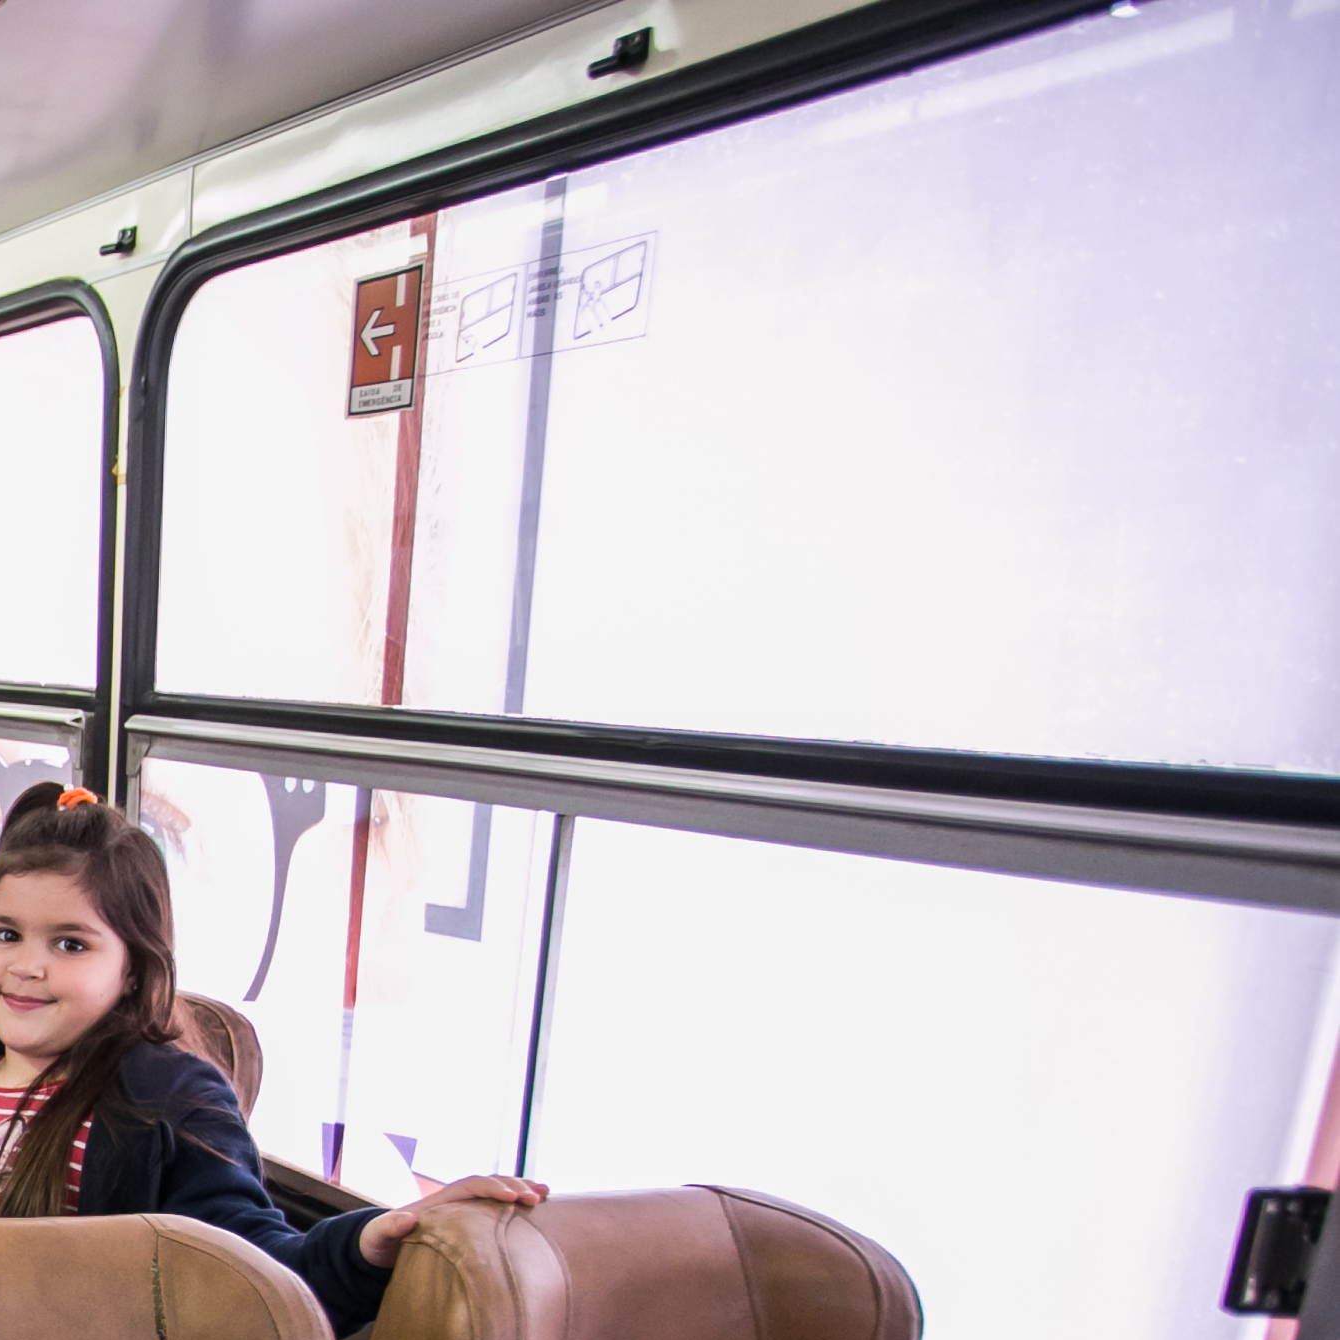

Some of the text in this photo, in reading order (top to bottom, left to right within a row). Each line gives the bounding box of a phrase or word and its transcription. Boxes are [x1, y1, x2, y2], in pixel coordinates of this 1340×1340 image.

[359, 383, 403, 398] SAÍDA DE
[358, 394, 402, 408] EMERGÊNCIA
